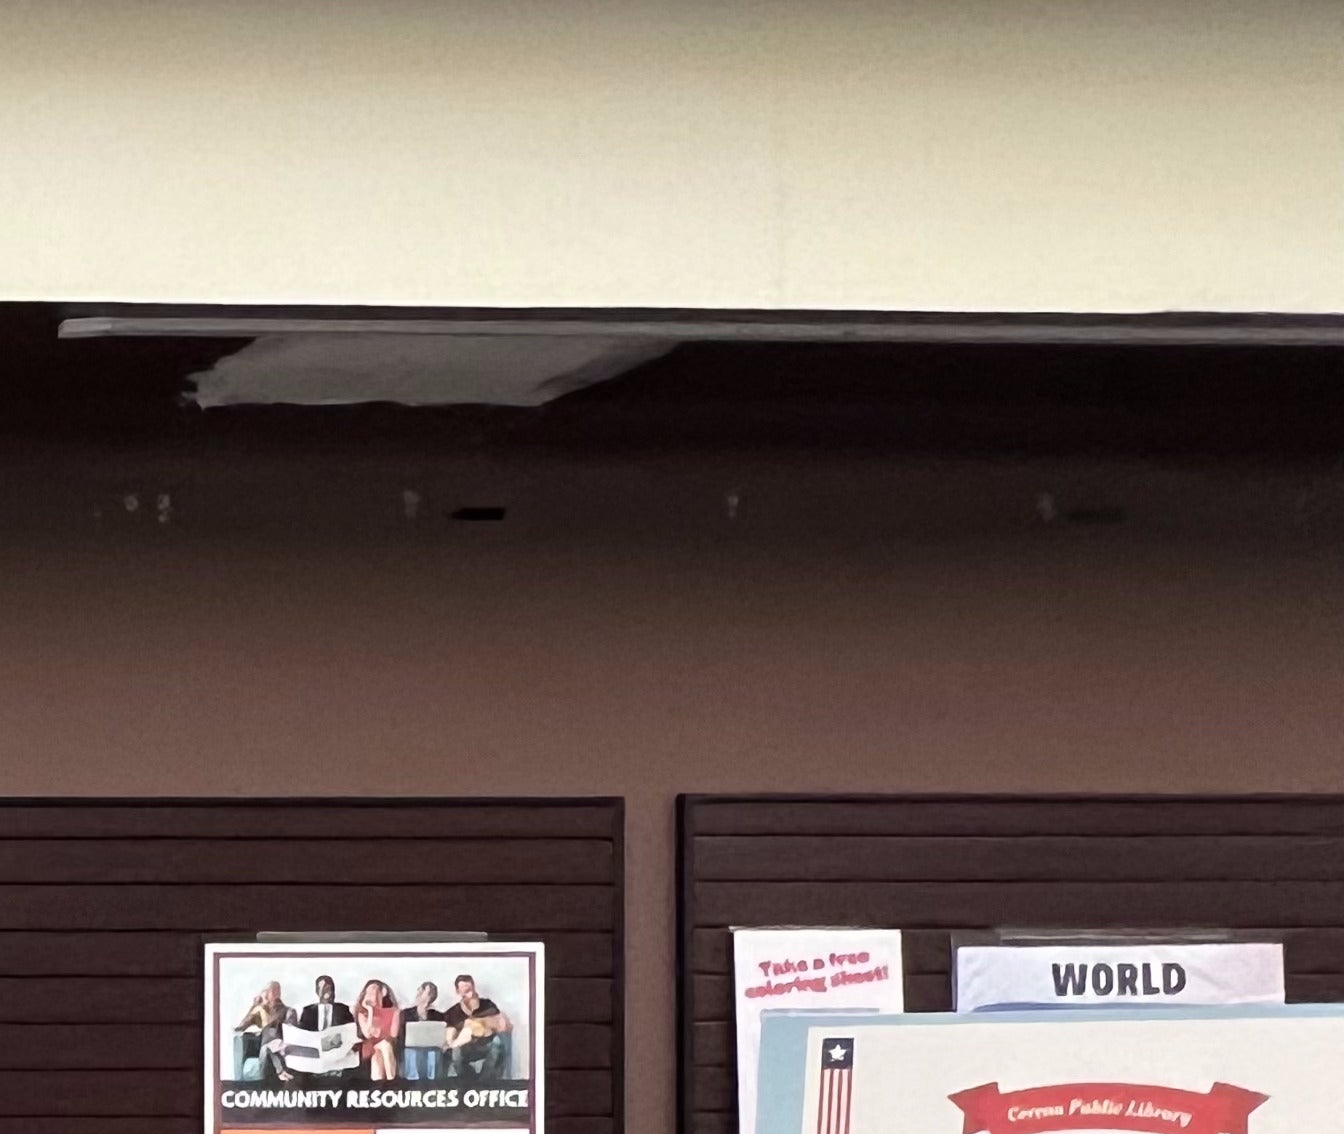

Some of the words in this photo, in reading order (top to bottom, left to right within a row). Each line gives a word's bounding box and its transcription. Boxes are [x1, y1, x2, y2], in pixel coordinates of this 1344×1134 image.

[744, 977, 827, 998] coloring
[1051, 962, 1188, 997] WORLD
[221, 1090, 342, 1108] COMMUNITY
[346, 1090, 459, 1108] RESOURCES
[464, 1089, 528, 1108] OFFICE
[1008, 1106, 1064, 1122] Corona
[1069, 1098, 1123, 1115] Public
[1125, 1100, 1192, 1128] Library
